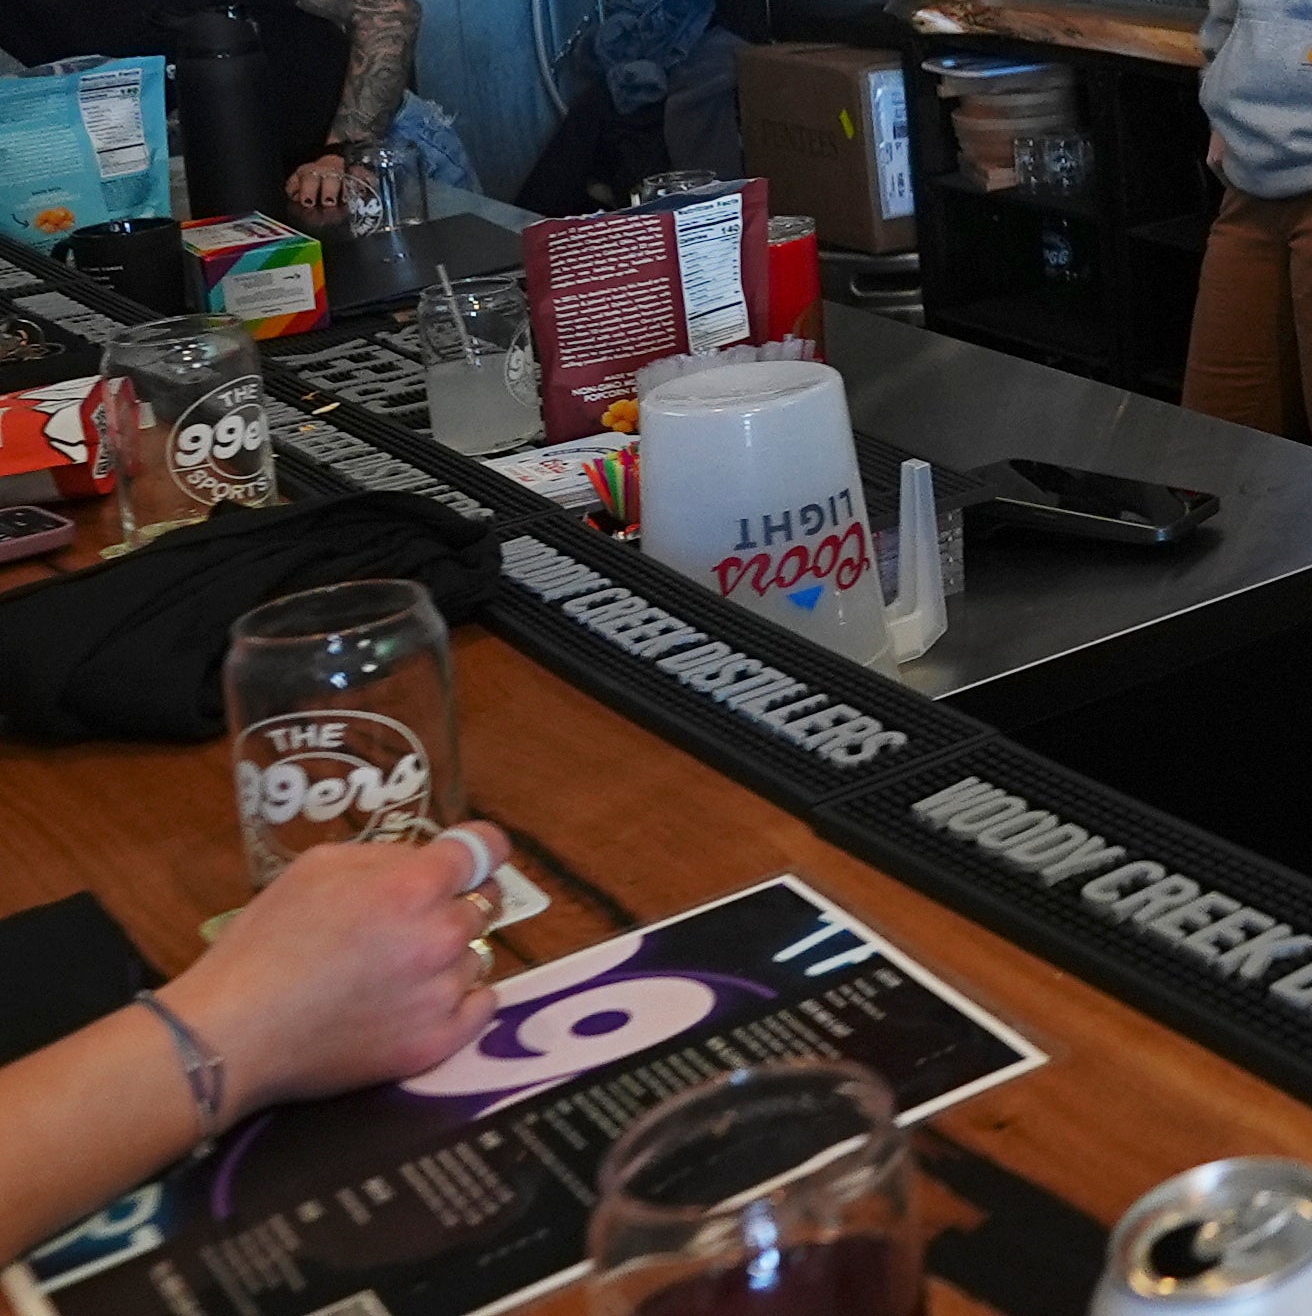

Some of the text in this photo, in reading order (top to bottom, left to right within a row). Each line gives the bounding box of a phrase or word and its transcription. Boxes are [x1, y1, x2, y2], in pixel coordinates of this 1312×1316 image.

[720, 224, 741, 235] 140
[217, 383, 259, 407] THE
[734, 488, 855, 550] LIGHT
[711, 522, 869, 598] Coors
[500, 534, 908, 769] OODY CREEK DISTILLERS
[264, 722, 348, 752] THE
[909, 773, 1127, 887] WOODY
